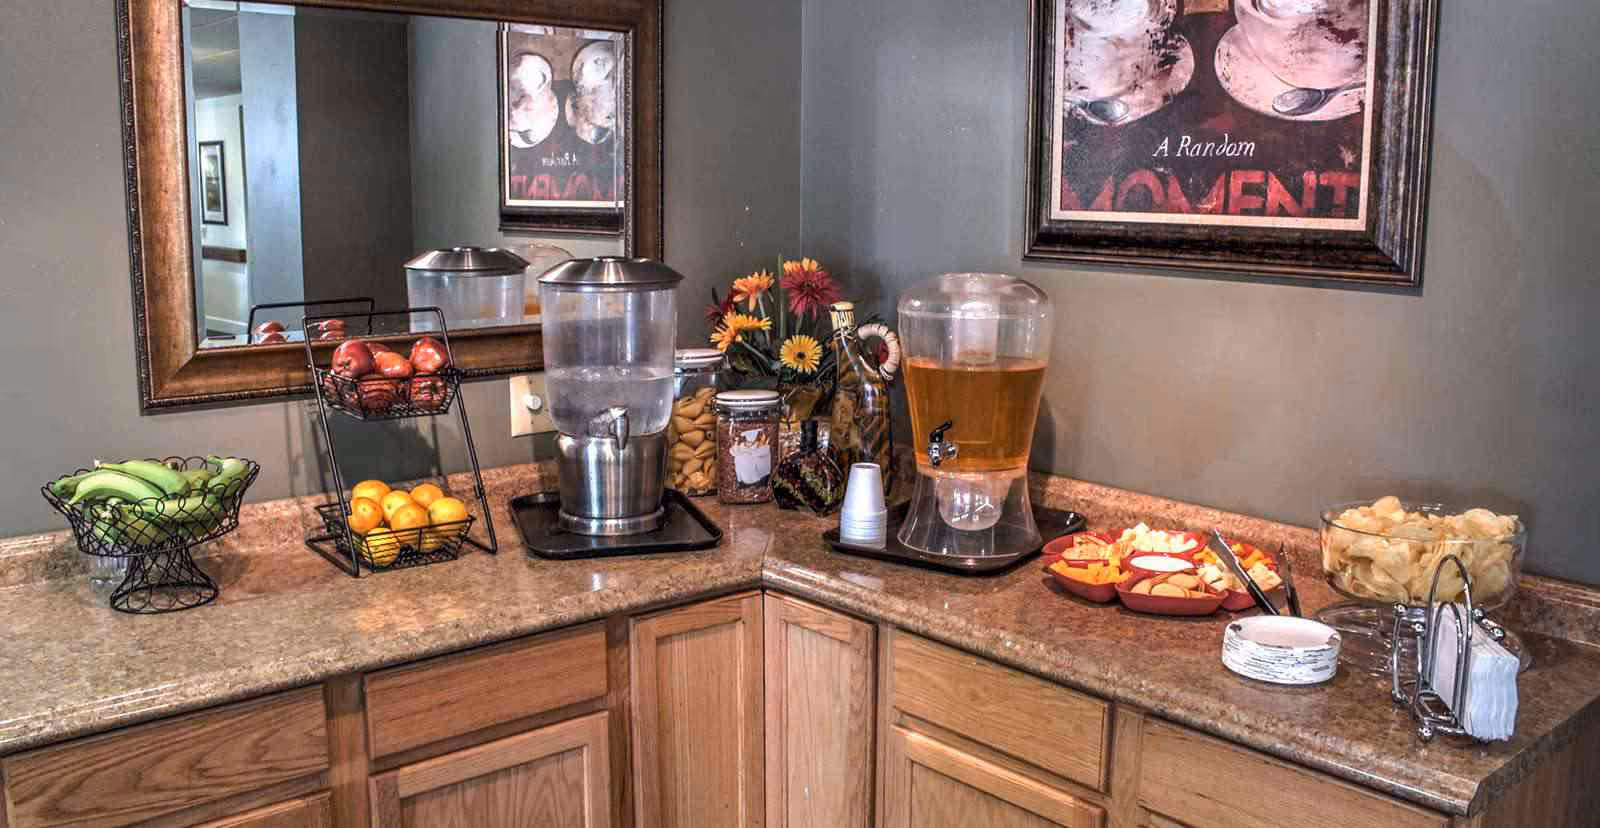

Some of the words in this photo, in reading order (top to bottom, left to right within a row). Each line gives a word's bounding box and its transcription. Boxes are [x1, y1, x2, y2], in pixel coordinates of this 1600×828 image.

[1152, 136, 1168, 157] A
[1176, 133, 1255, 157] Random
[1061, 168, 1361, 217] MOMENT
